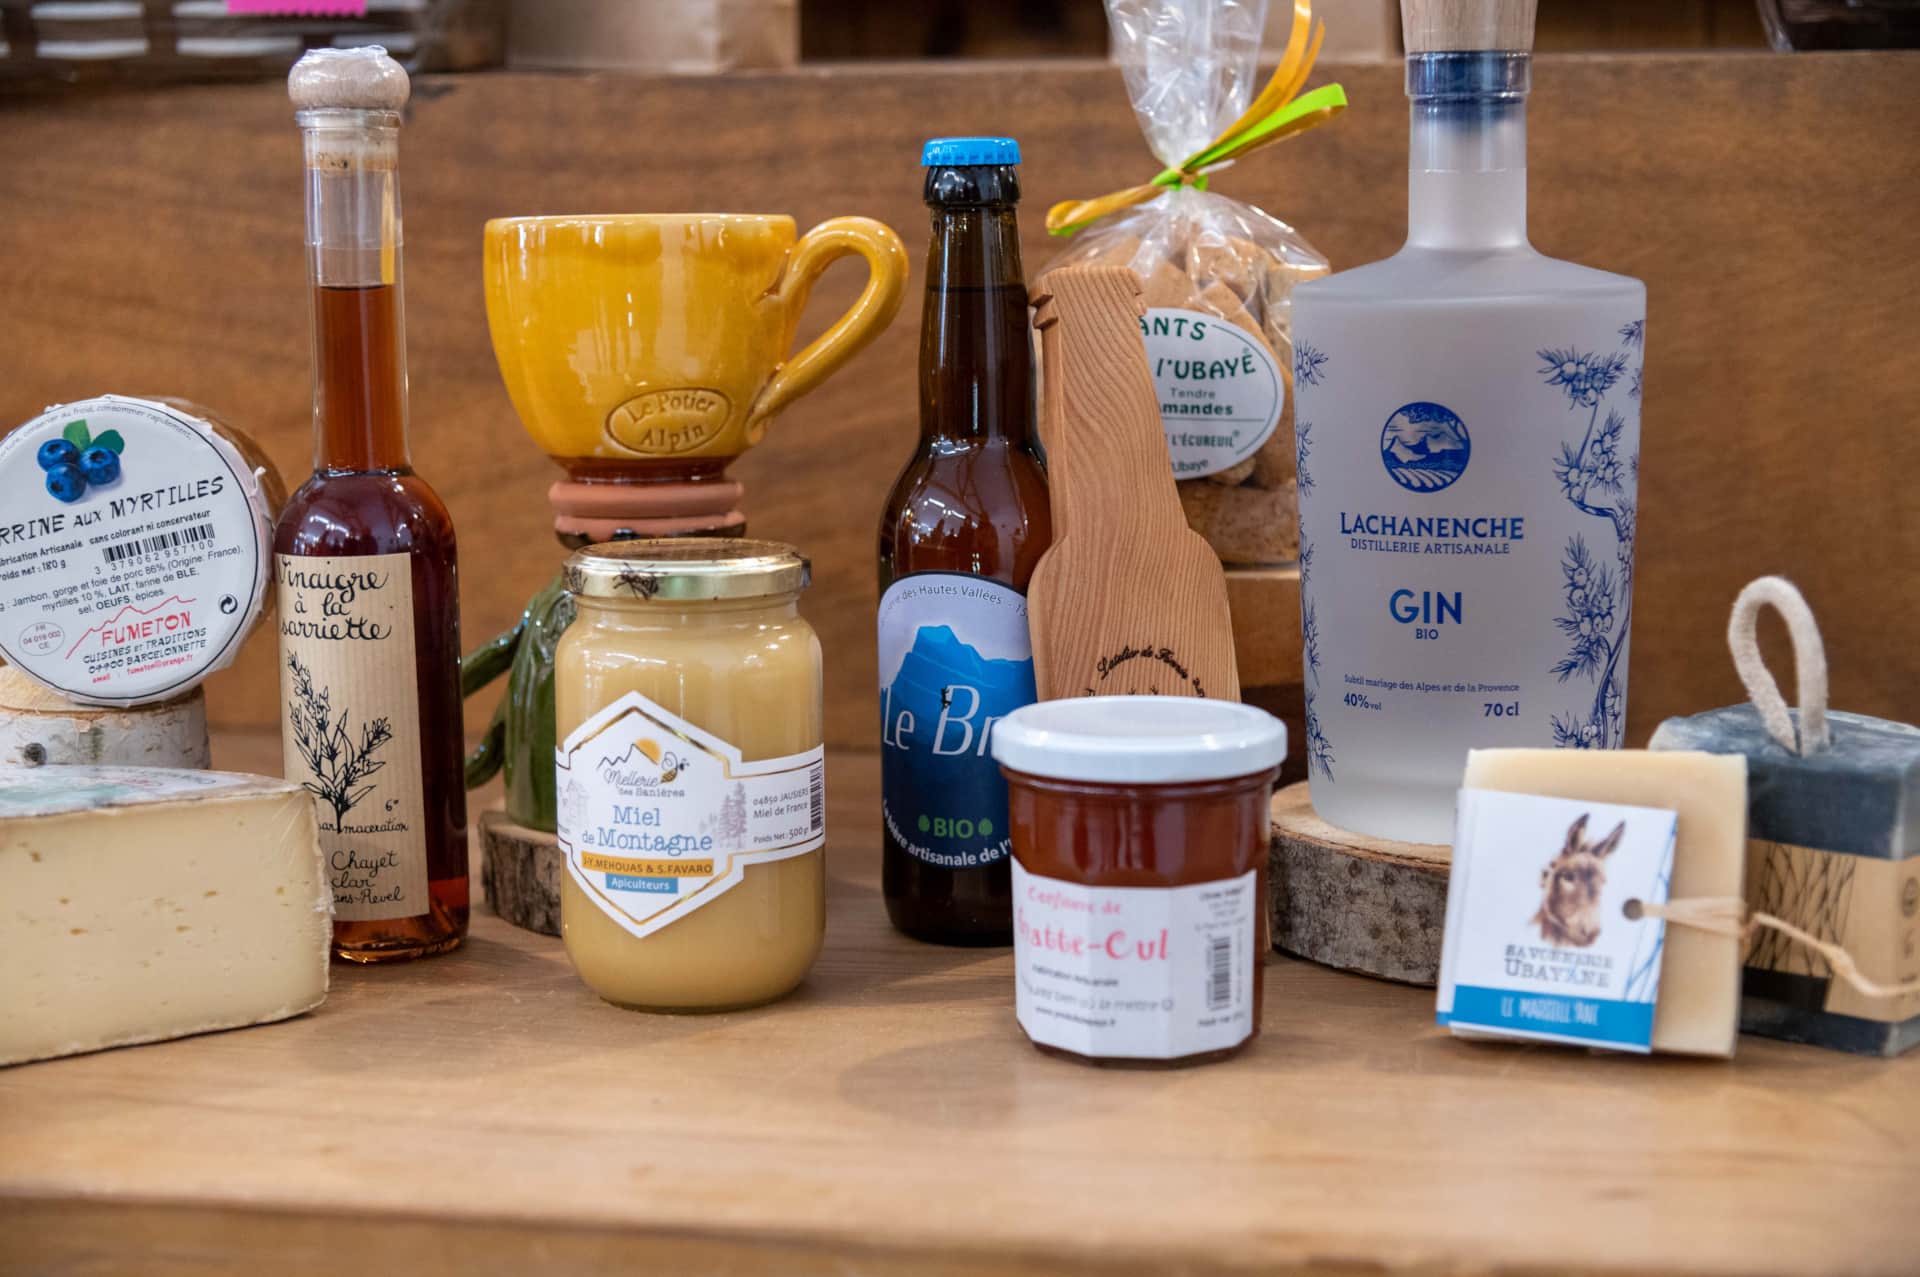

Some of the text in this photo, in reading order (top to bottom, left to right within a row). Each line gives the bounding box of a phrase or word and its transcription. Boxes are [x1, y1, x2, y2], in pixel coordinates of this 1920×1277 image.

[1171, 387, 1216, 399] Tendre
[624, 391, 716, 425] Le Potier
[1160, 403, 1233, 415] mandes
[640, 424, 705, 451] Alpin
[73, 510, 102, 528] AUX
[109, 476, 224, 519] MYRTILLES
[40, 540, 83, 556] Artisanale
[89, 533, 109, 545] sans
[110, 525, 145, 539] colorant
[146, 523, 155, 531] ni
[156, 510, 212, 530] conservateur
[1340, 511, 1525, 540] LACHANENCHE
[94, 539, 214, 575] 3 379062 957100
[1350, 537, 1511, 555] DISTILLERIE ARTISANALE
[21, 566, 36, 576] net
[41, 560, 58, 571] 180
[60, 560, 66, 569] g
[53, 585, 79, 598] gorge
[80, 581, 90, 591] et
[91, 577, 109, 587] foie
[110, 574, 122, 584] de
[124, 570, 143, 582] porc
[145, 563, 166, 575] 86%
[280, 556, 389, 604] Vinaigre
[42, 597, 80, 612] myrtilles
[82, 592, 93, 601] 10
[136, 578, 161, 590] farine
[163, 574, 175, 582] de
[294, 591, 352, 616] à la
[918, 584, 958, 595] Hautes
[960, 584, 1002, 604] Vallées
[1388, 588, 1462, 625] GIN
[101, 610, 191, 648] FUMETON
[281, 616, 393, 640] sarriette
[1415, 628, 1439, 641] BIO
[82, 645, 131, 664] CUISINES
[145, 627, 207, 649] TRADITIONS
[126, 639, 207, 666] BARCELONNETTE
[1344, 673, 1520, 693] Subtil mariage des Alpes et de la Provence
[881, 686, 915, 750] Le
[613, 805, 662, 827] Miel
[753, 801, 808, 819] Miel de France
[933, 816, 975, 839] BIO
[582, 830, 595, 844] de
[597, 827, 713, 857] Montagne
[907, 842, 977, 867] artisanale
[979, 847, 1000, 863] de
[999, 838, 1013, 855] l'
[646, 864, 654, 873] &
[611, 877, 671, 891] Apiculteurs
[1101, 901, 1121, 914] de
